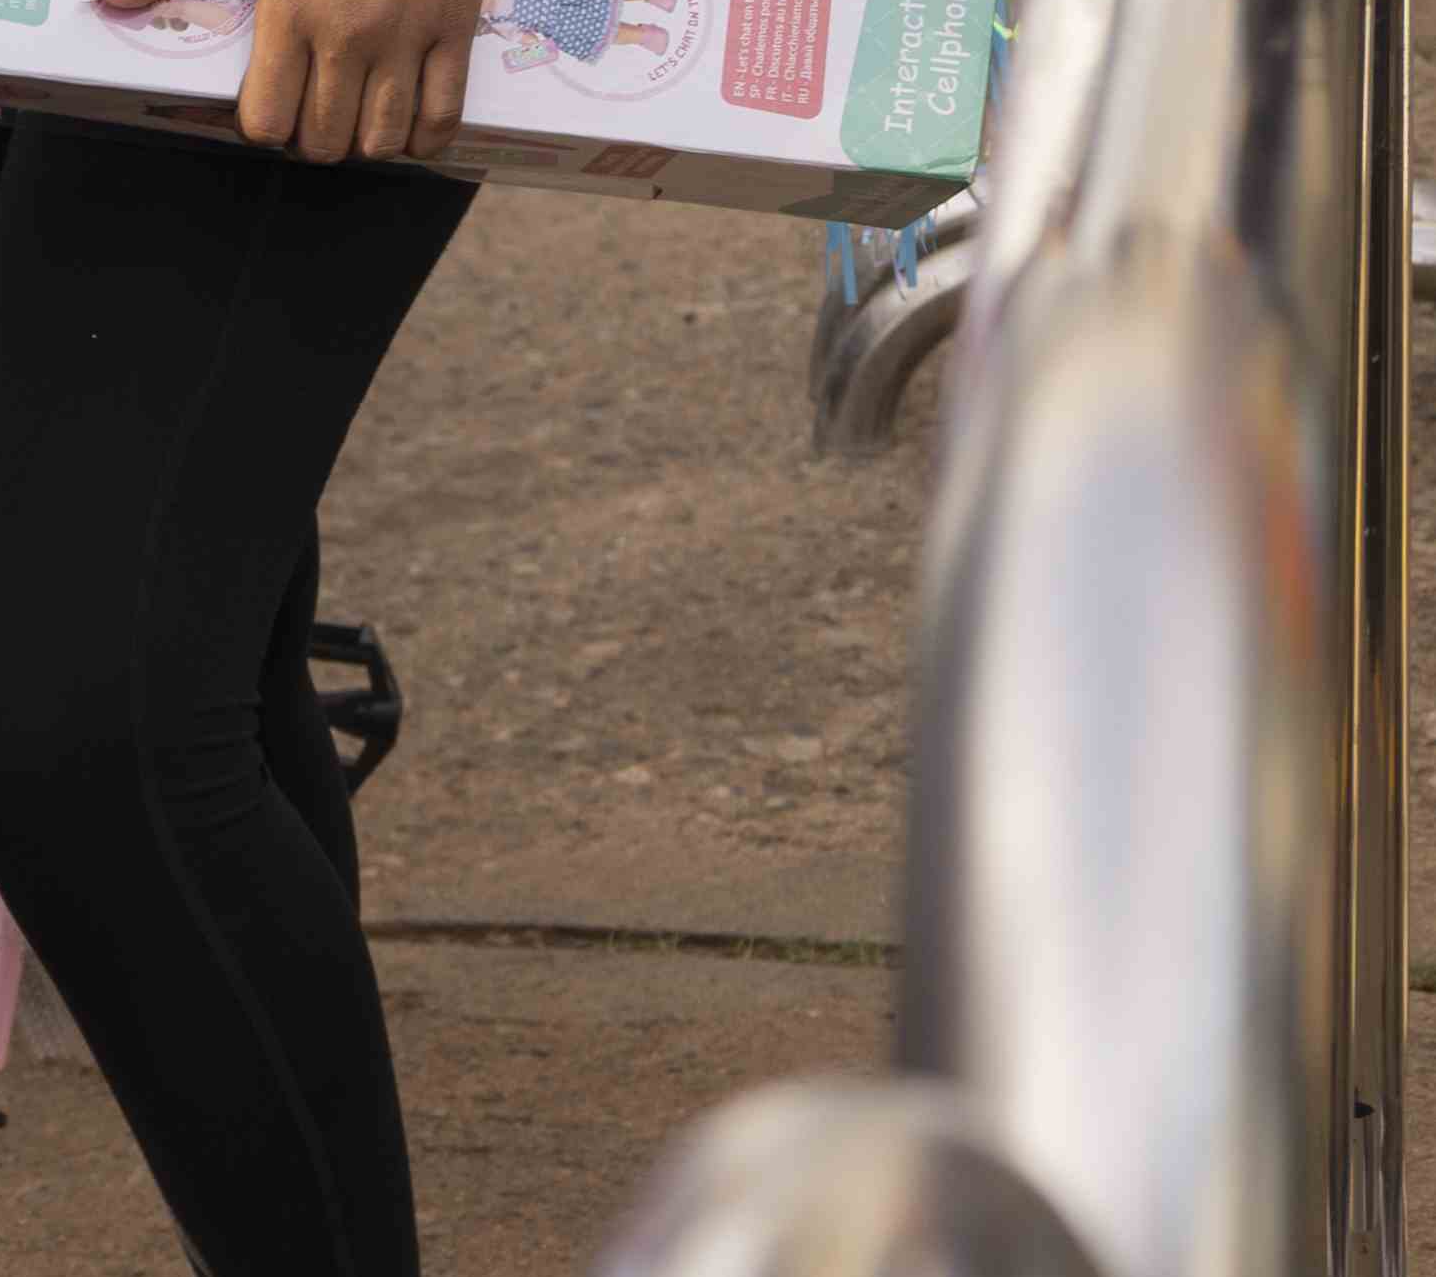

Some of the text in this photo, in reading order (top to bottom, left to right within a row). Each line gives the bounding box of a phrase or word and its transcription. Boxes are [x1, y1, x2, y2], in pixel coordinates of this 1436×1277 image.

[744, 5, 753, 19] on
[777, 8, 785, 22] au
[675, 29, 696, 57] CHAT
[688, 11, 698, 25] ON
[738, 21, 751, 46] chat
[752, 17, 768, 77] Charlemos
[768, 23, 784, 77] Discutons
[736, 47, 748, 72] Let's
[733, 80, 745, 97] EN
[749, 83, 761, 98] SP
[765, 85, 777, 100] FR
[781, 91, 792, 102] IT
[797, 87, 809, 104] RU
